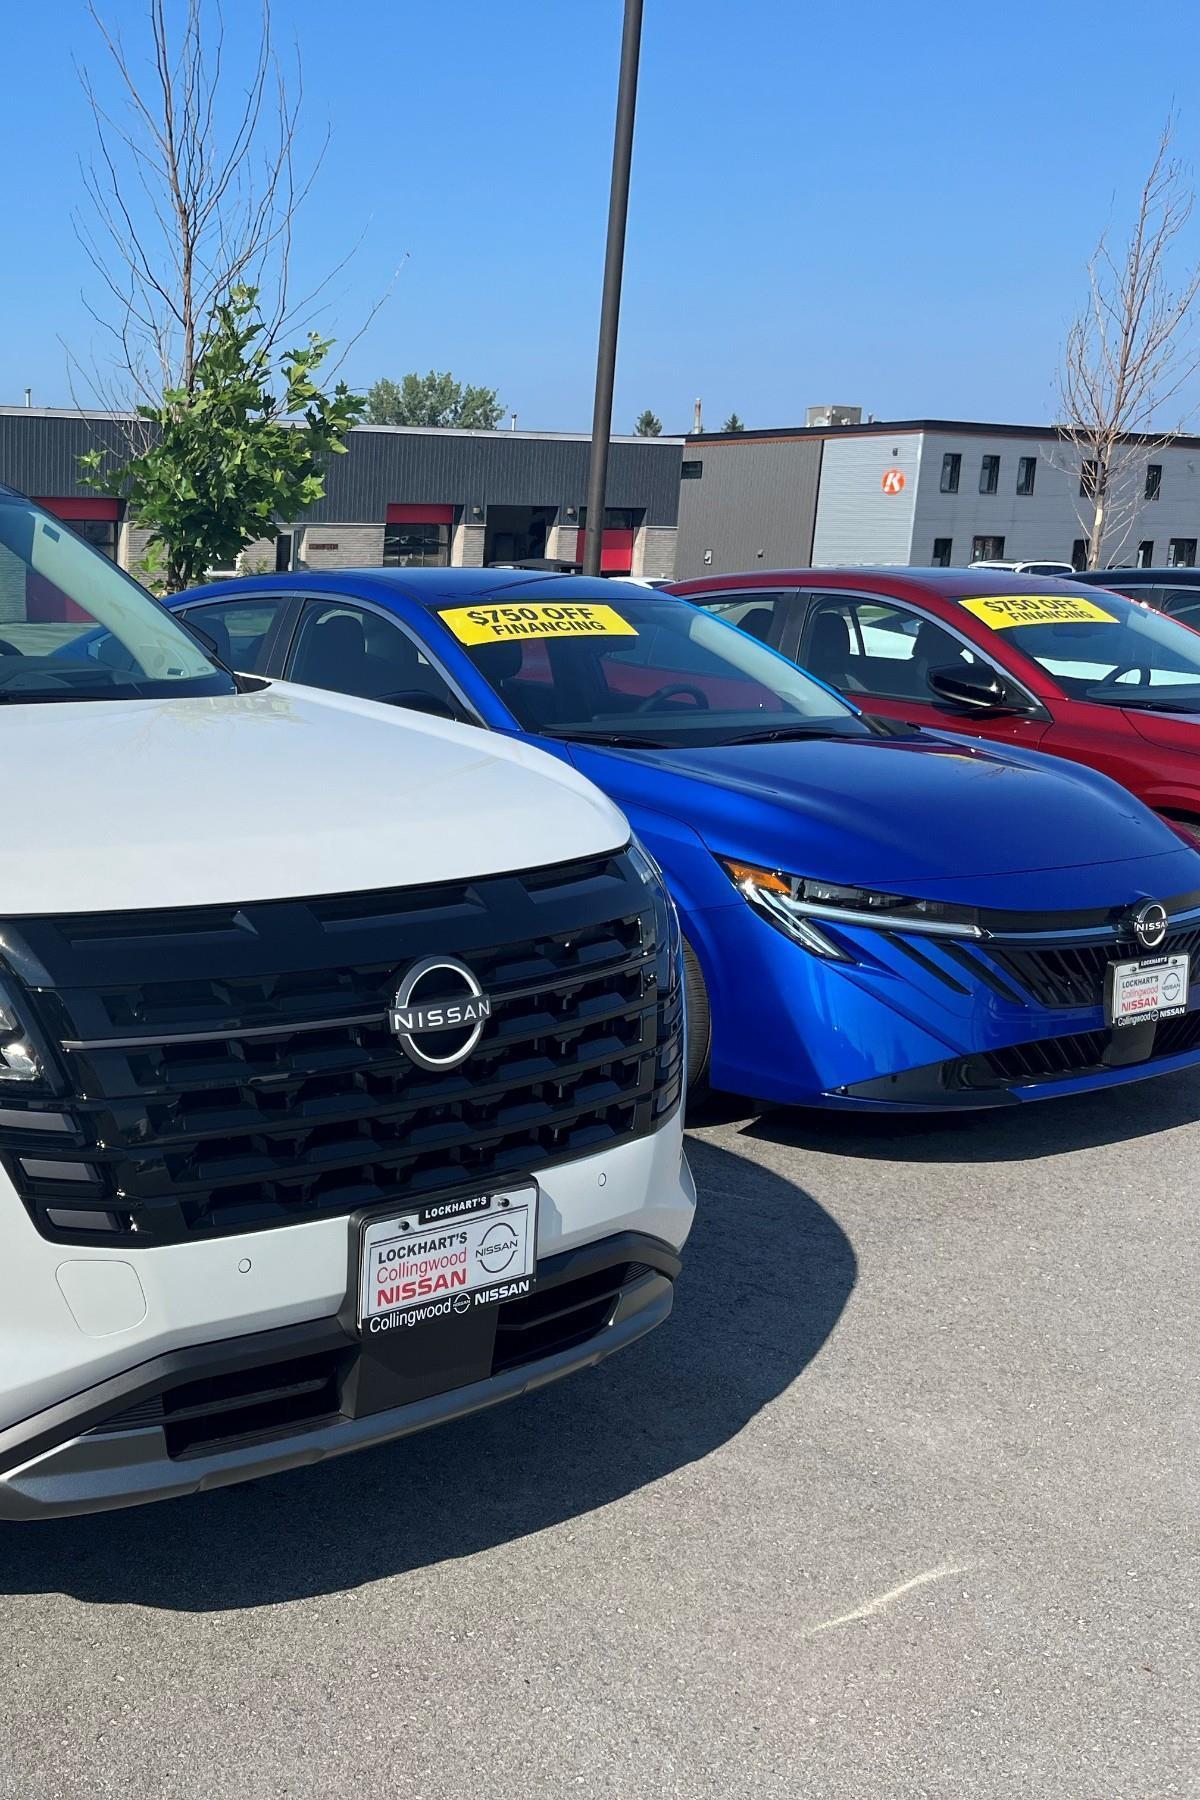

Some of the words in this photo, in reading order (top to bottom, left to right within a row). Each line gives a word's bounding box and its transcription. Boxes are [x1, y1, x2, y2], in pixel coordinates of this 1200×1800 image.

[466, 607, 539, 626] $750
[542, 606, 595, 620] OFF
[983, 599, 1041, 613] $750
[1041, 599, 1080, 610] OFF
[1009, 609, 1095, 621] FINANCING
[491, 621, 608, 636] FINANCING
[1122, 975, 1159, 989] LOCKHART'S
[1121, 985, 1158, 1000] Collingwood
[1121, 996, 1158, 1013] NISSAN
[1160, 1007, 1185, 1018] NISSAN
[394, 1000, 490, 1030] NISSAN
[425, 1196, 488, 1219] LOCKHART'S
[378, 1231, 468, 1264] LOCKHART'S
[475, 1239, 519, 1259] NISSAN
[377, 1247, 468, 1284] Collingwood
[377, 1268, 468, 1307] NISSAN
[369, 1297, 451, 1333] Collingwood
[474, 1279, 530, 1306] NISSAN
